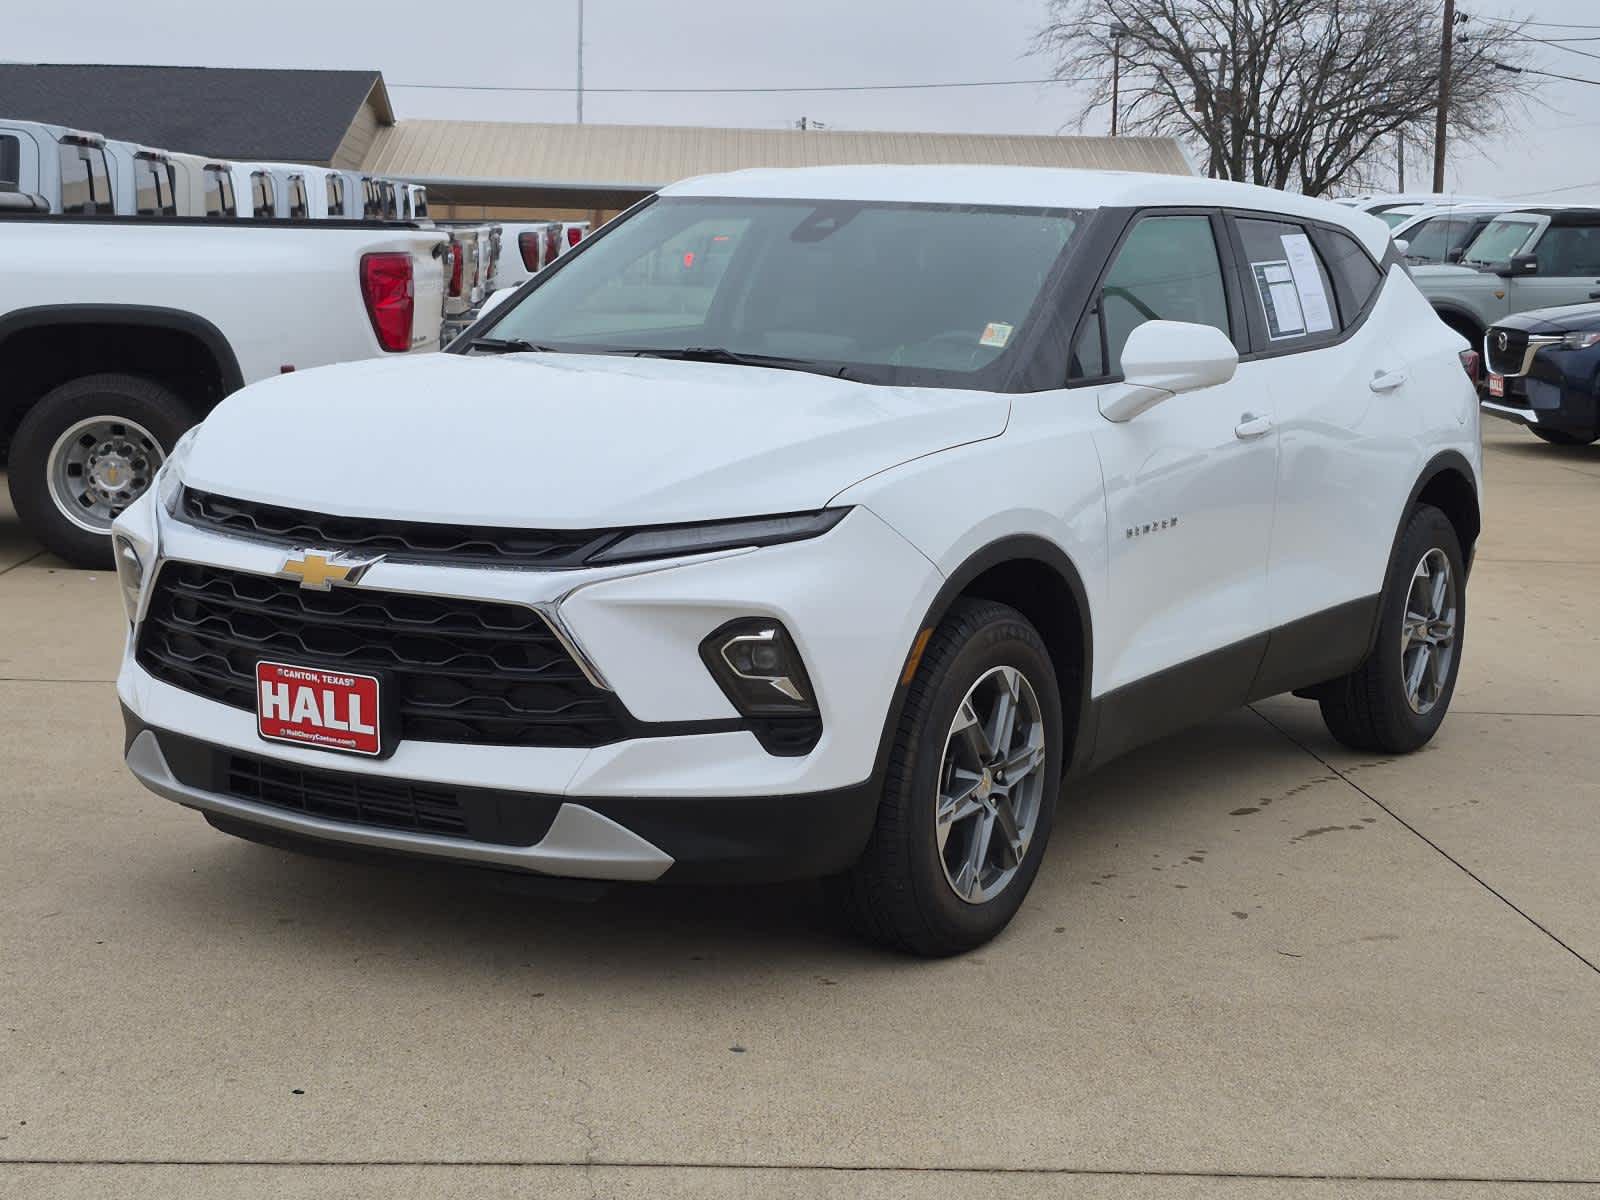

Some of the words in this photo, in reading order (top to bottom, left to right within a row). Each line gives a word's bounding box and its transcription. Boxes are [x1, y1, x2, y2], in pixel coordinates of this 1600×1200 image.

[283, 670, 321, 683] CANTON,
[323, 675, 351, 686] TEXAS
[261, 680, 375, 735] HALL
